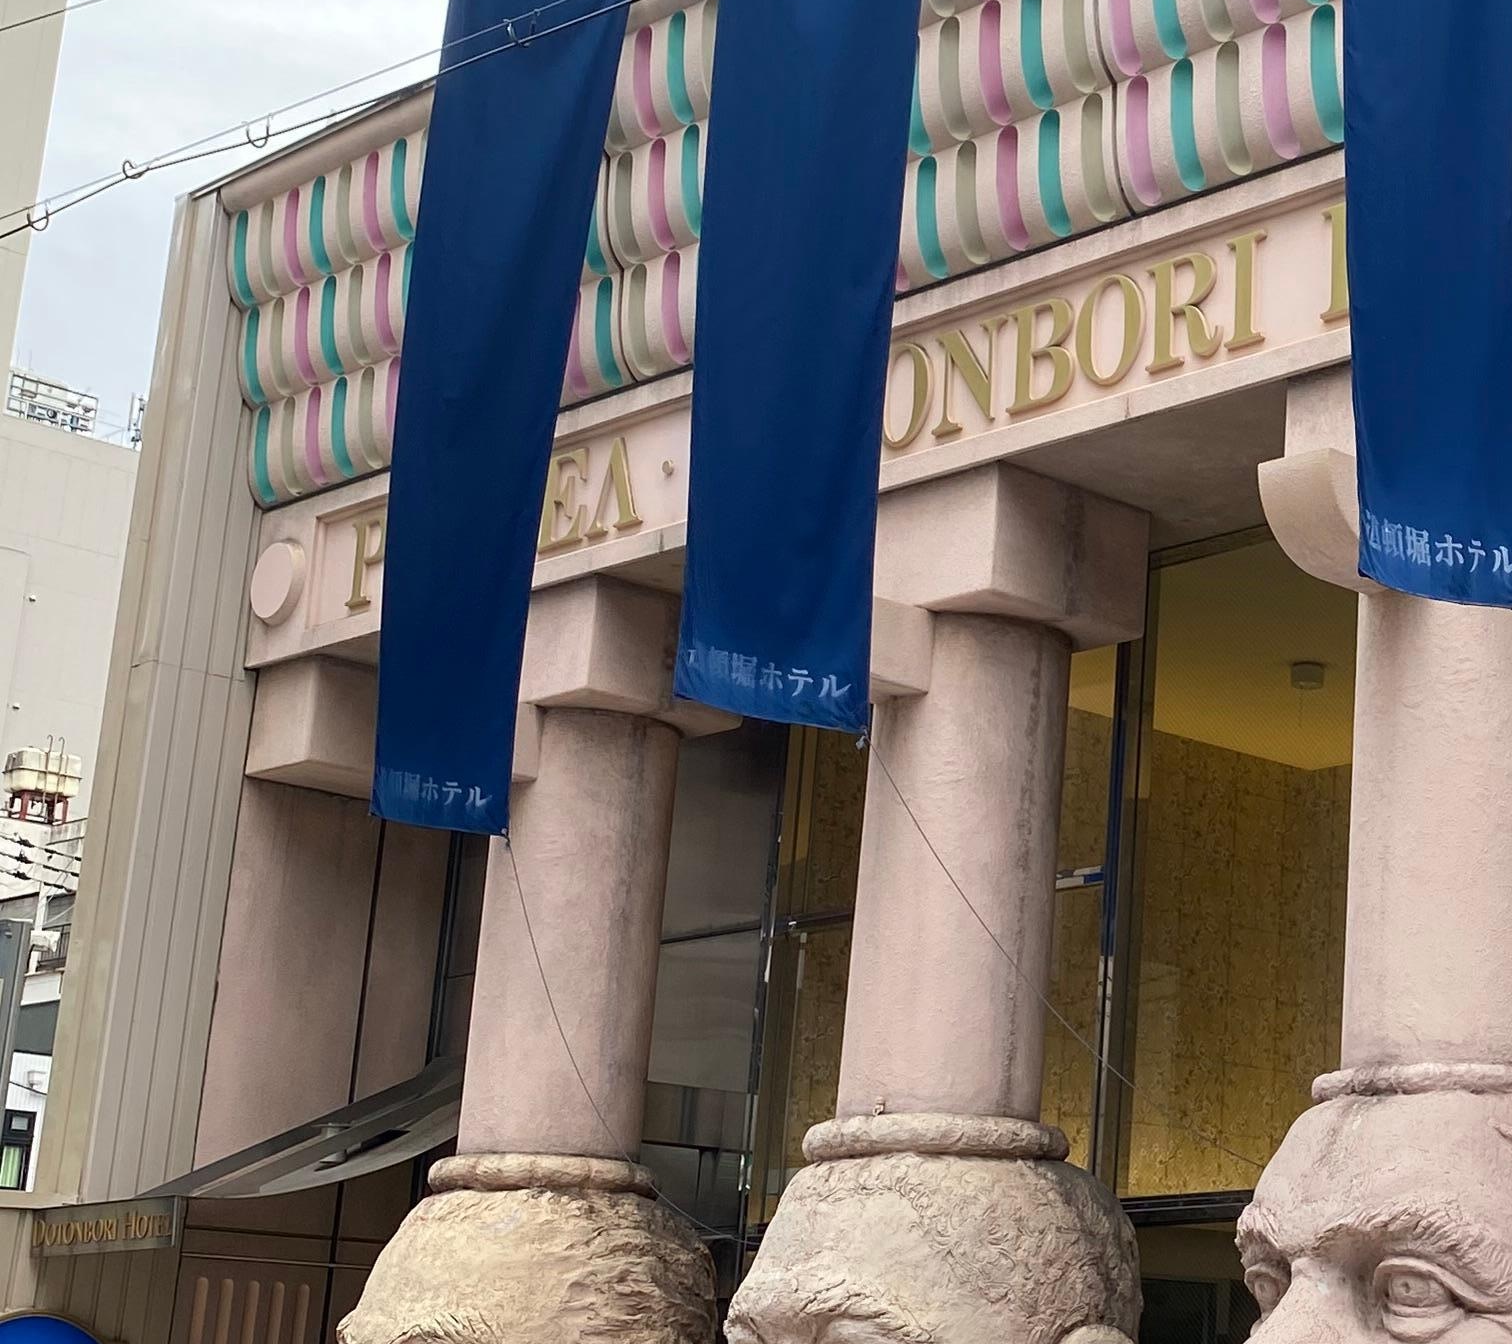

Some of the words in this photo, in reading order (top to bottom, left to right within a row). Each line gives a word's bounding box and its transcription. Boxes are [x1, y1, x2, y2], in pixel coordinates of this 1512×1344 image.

[883, 229, 1268, 449] ONBORI
[32, 1217, 118, 1247] DOTONBORI
[122, 1210, 172, 1241] HOTEL
